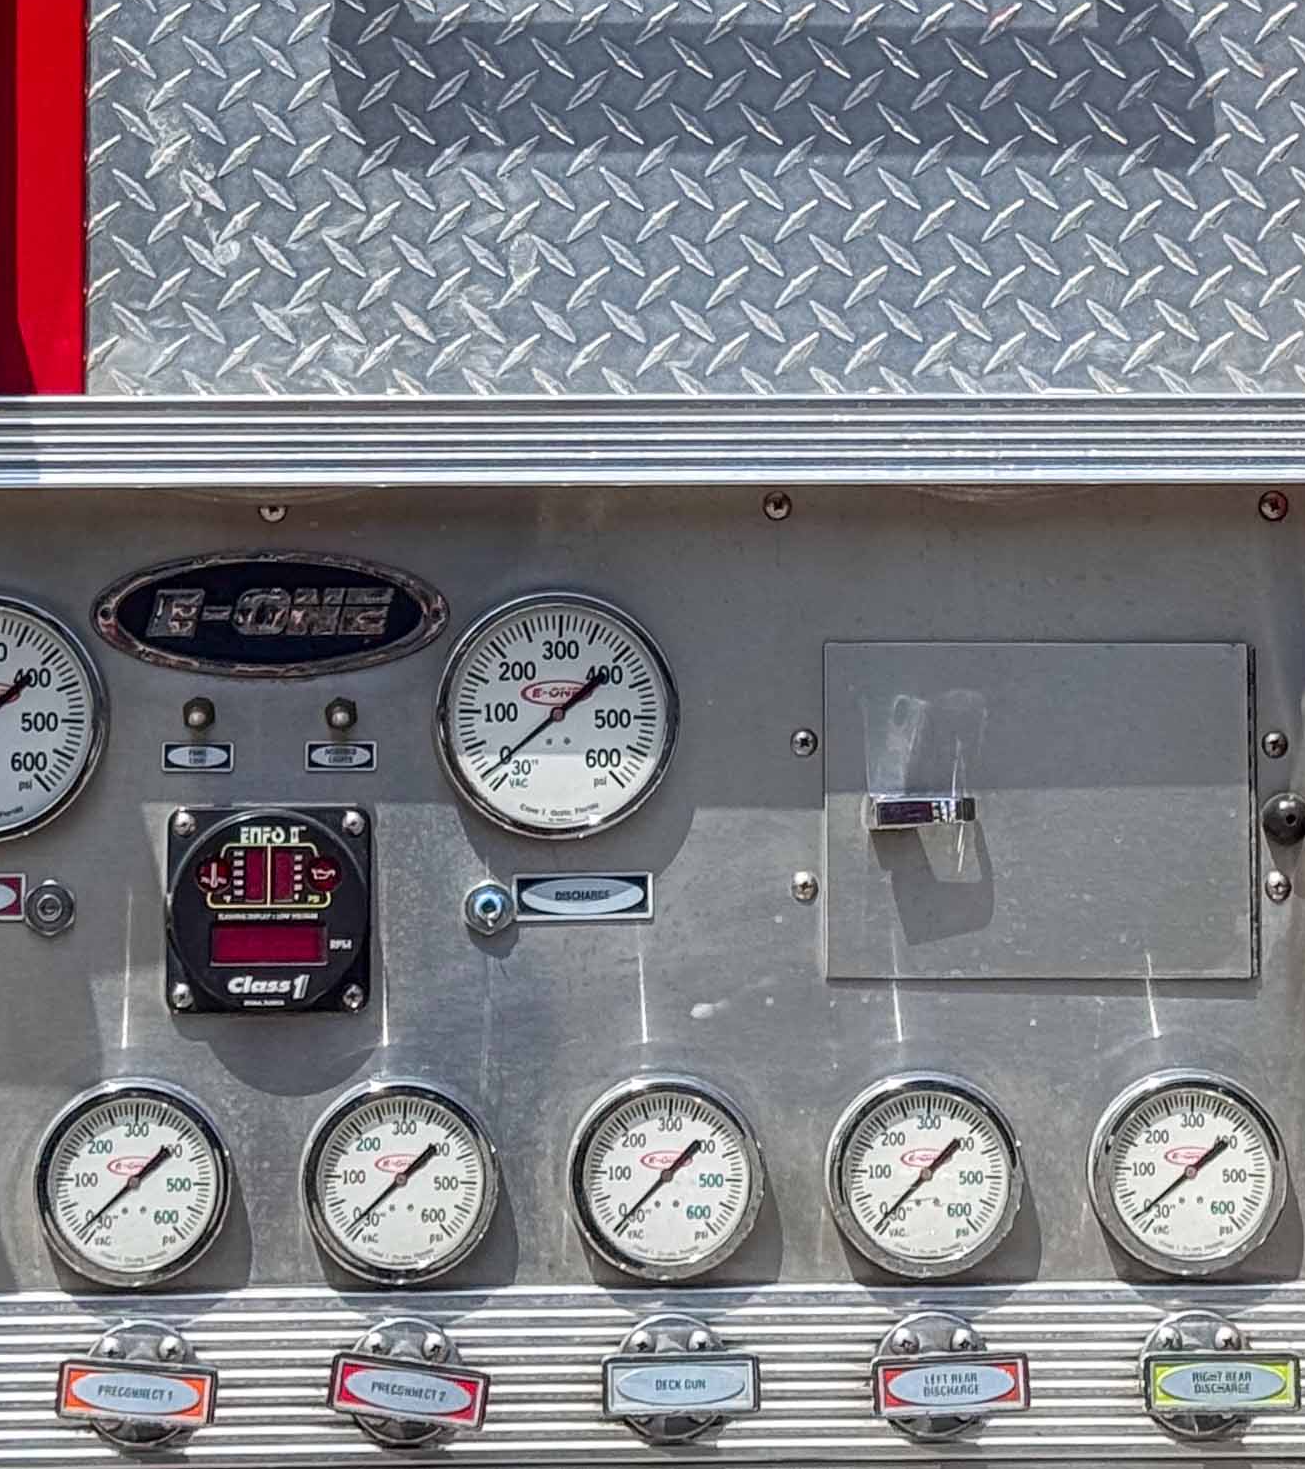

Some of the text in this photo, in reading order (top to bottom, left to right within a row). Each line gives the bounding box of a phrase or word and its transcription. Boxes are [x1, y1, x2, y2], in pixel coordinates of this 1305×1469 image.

[147, 588, 394, 637] E-ONE
[542, 640, 579, 660] 300
[499, 662, 536, 681] 200
[484, 703, 518, 722] 100
[594, 709, 631, 728] 500
[21, 713, 58, 732] 500
[11, 752, 47, 771] 600
[499, 746, 511, 764] 0
[586, 749, 621, 767] 600
[19, 780, 33, 791] psi
[509, 777, 528, 787] VAC
[593, 777, 607, 787] psi
[555, 890, 610, 901] DISCHARGE
[392, 1121, 416, 1135] 300
[658, 1117, 682, 1131] 300
[917, 1116, 941, 1130] 300
[1181, 1114, 1204, 1128] 300
[124, 1123, 149, 1137] 300
[1144, 1130, 1169, 1144] 200
[356, 1137, 381, 1152] 200
[622, 1133, 646, 1148] 200
[881, 1132, 906, 1146] 200
[87, 1140, 112, 1154] 200
[608, 1166, 631, 1180] 100
[868, 1165, 891, 1179] 100
[1133, 1163, 1155, 1176] 100
[1223, 1169, 1247, 1183] 500
[74, 1174, 98, 1187] 100
[343, 1171, 366, 1184] 100
[434, 1176, 458, 1190] 500
[699, 1174, 723, 1188] 500
[959, 1171, 983, 1185] 500
[166, 1178, 191, 1192] 500
[686, 1205, 710, 1219] 600
[947, 1203, 971, 1217] 600
[1211, 1201, 1235, 1215] 600
[154, 1211, 178, 1224] 600
[421, 1209, 446, 1222] 600
[924, 1372, 978, 1384] LEFT REAR
[1192, 1371, 1252, 1382] RIGHT REAR
[371, 1381, 437, 1400] PRECONNECT
[655, 1379, 706, 1390] DECK GUN
[923, 1384, 978, 1397] DISCHARGE
[1194, 1383, 1250, 1394] DISCHARGE
[98, 1384, 173, 1401] PRECONNECT 1
